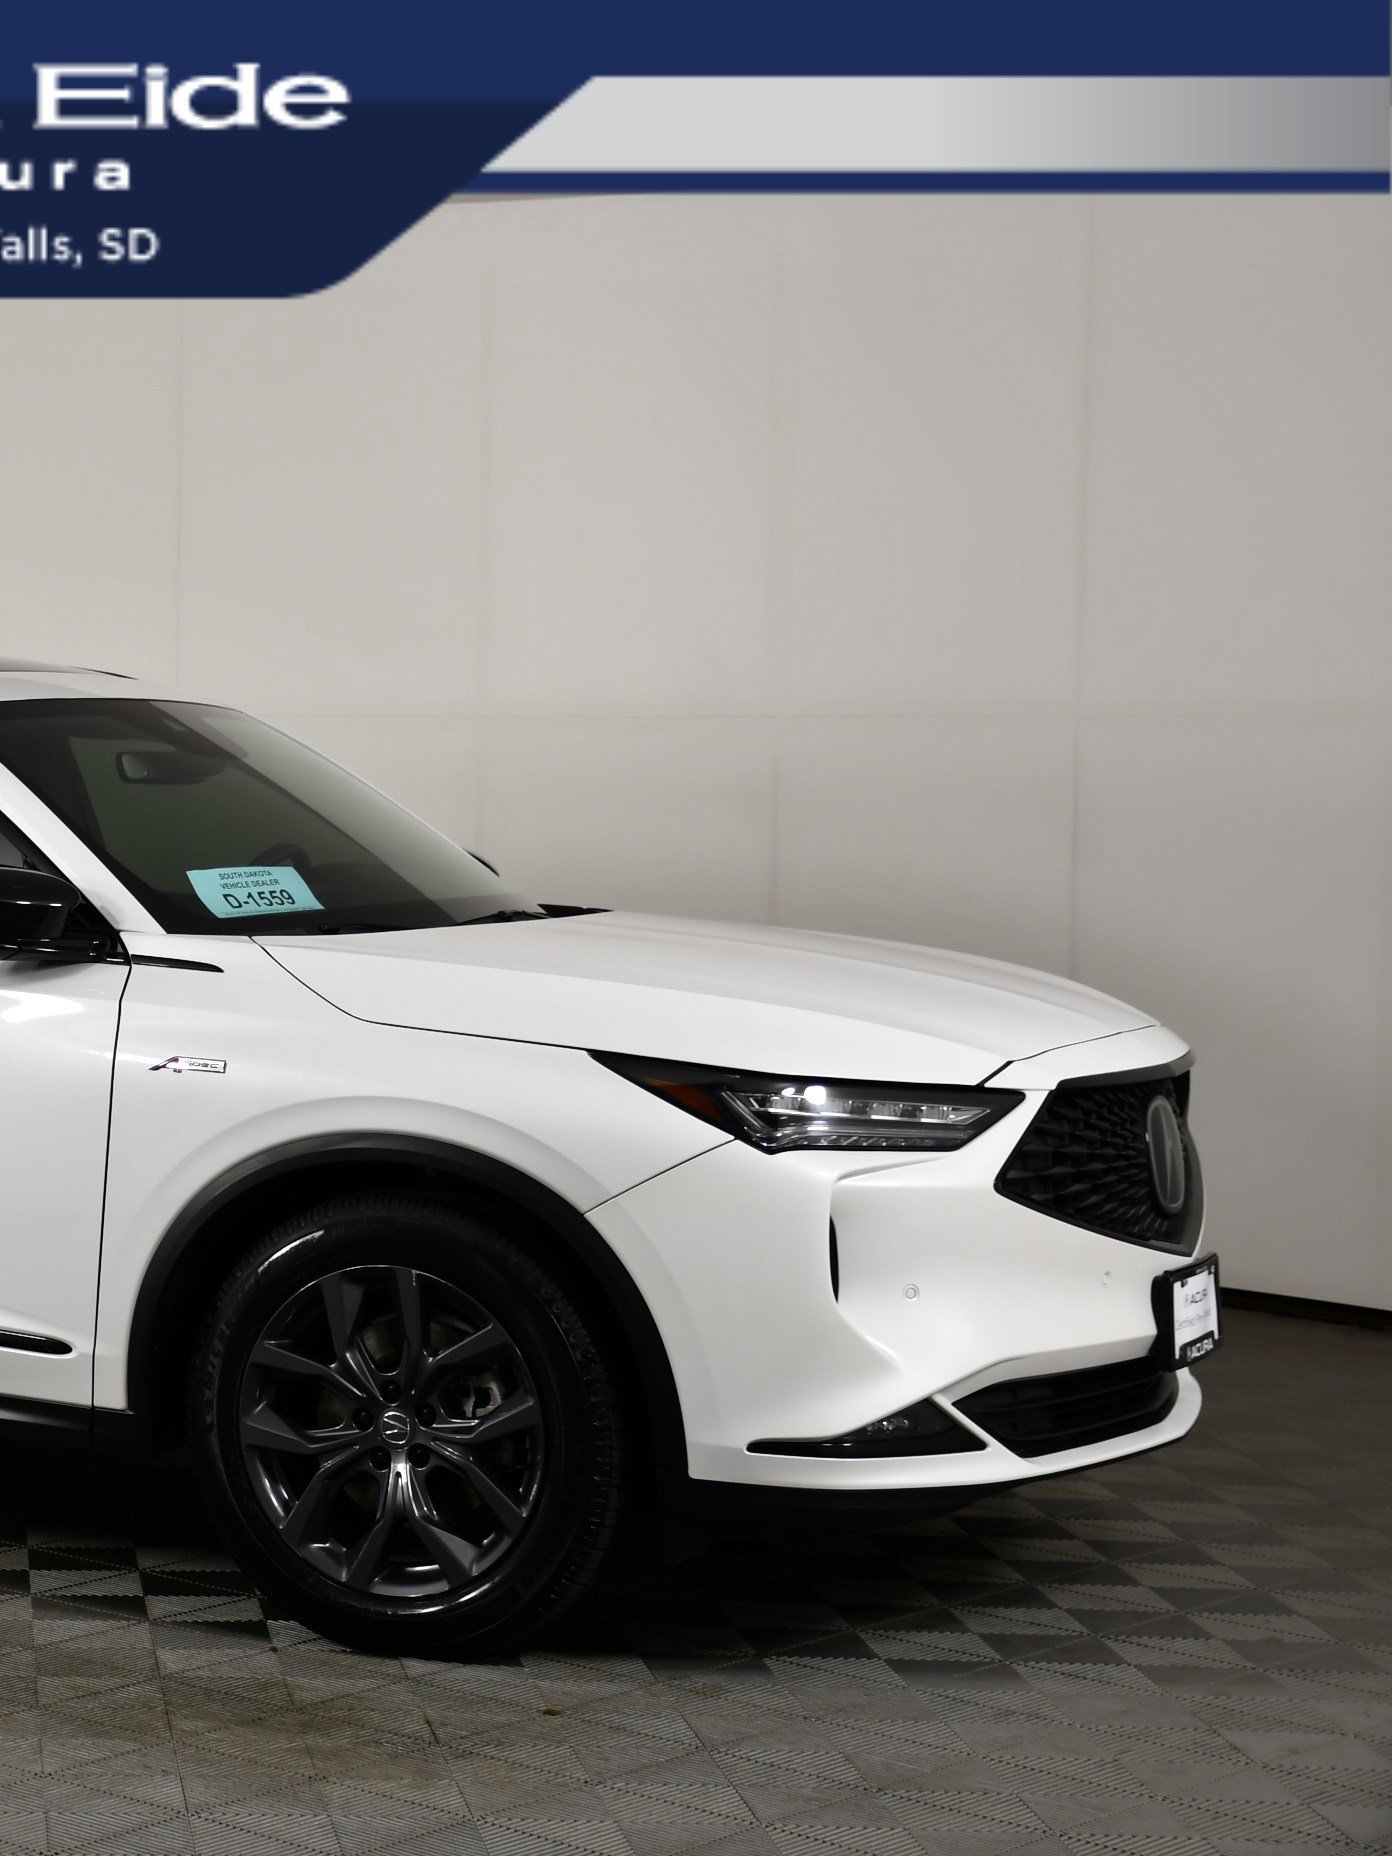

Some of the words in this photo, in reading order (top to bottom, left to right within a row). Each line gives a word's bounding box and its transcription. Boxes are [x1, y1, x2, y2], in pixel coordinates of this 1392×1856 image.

[218, 871, 243, 881] SOUTH
[243, 870, 273, 879] DAKOTA
[219, 881, 252, 890] VEHICLE
[251, 878, 281, 888] DEALER
[222, 889, 296, 909] D-1559
